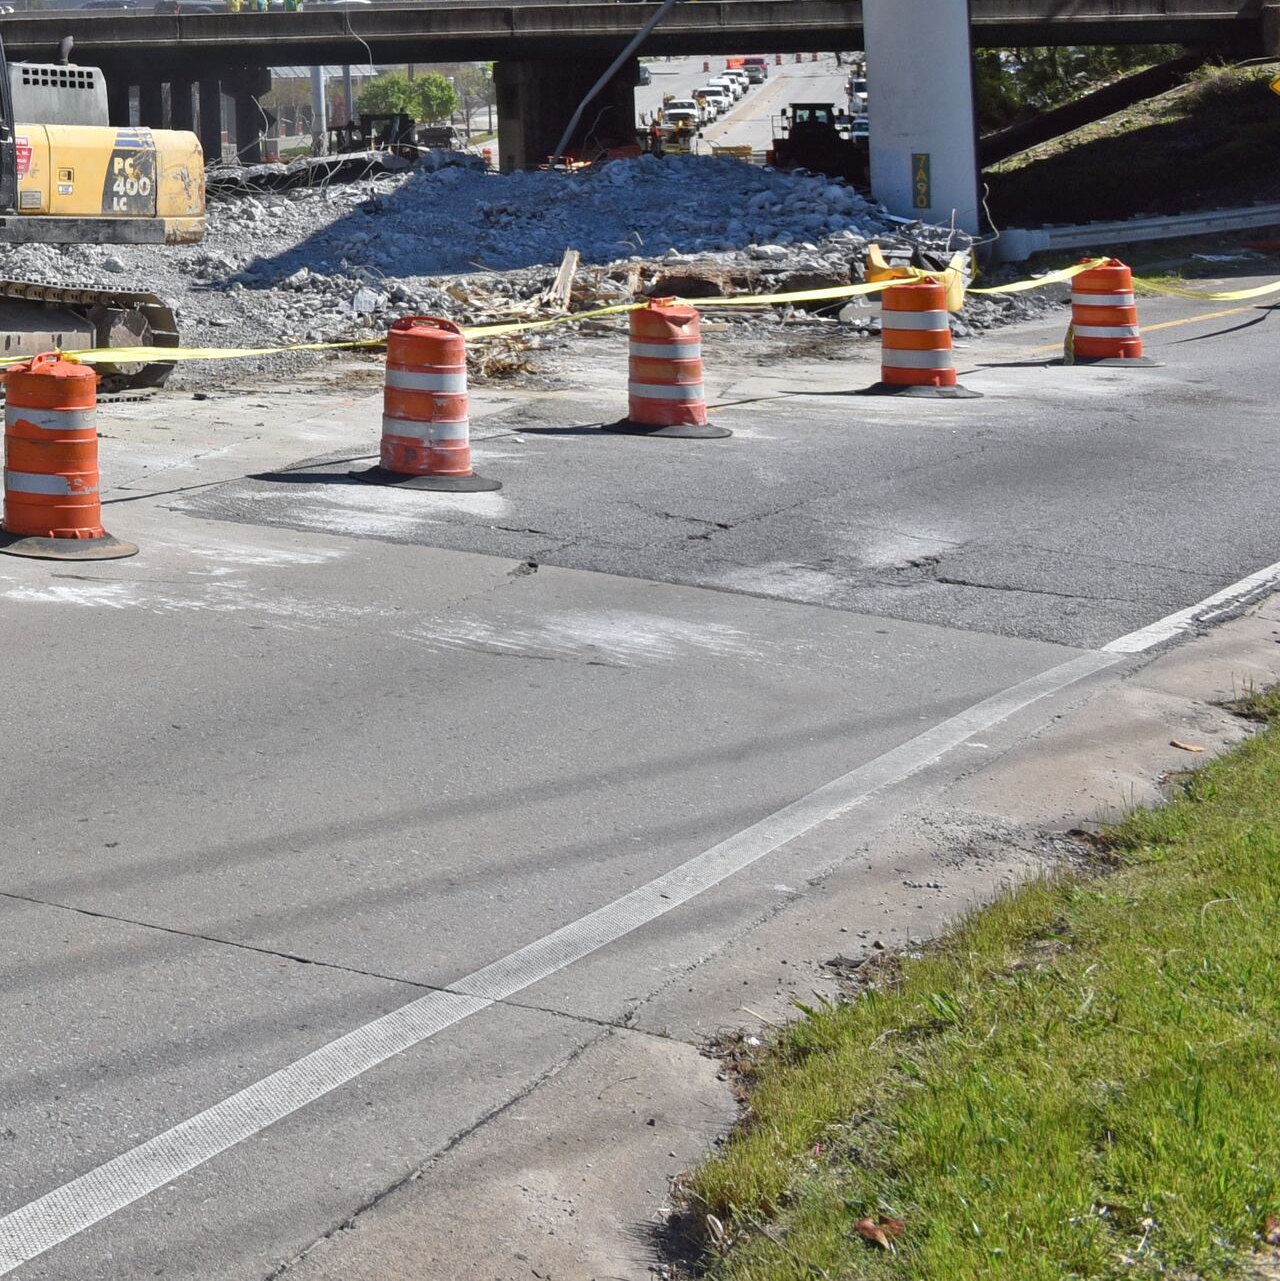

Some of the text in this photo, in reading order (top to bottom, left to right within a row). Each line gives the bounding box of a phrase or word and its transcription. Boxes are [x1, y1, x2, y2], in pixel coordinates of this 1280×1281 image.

[113, 157, 135, 174] PC
[112, 176, 151, 196] 400
[113, 197, 127, 211] LC
